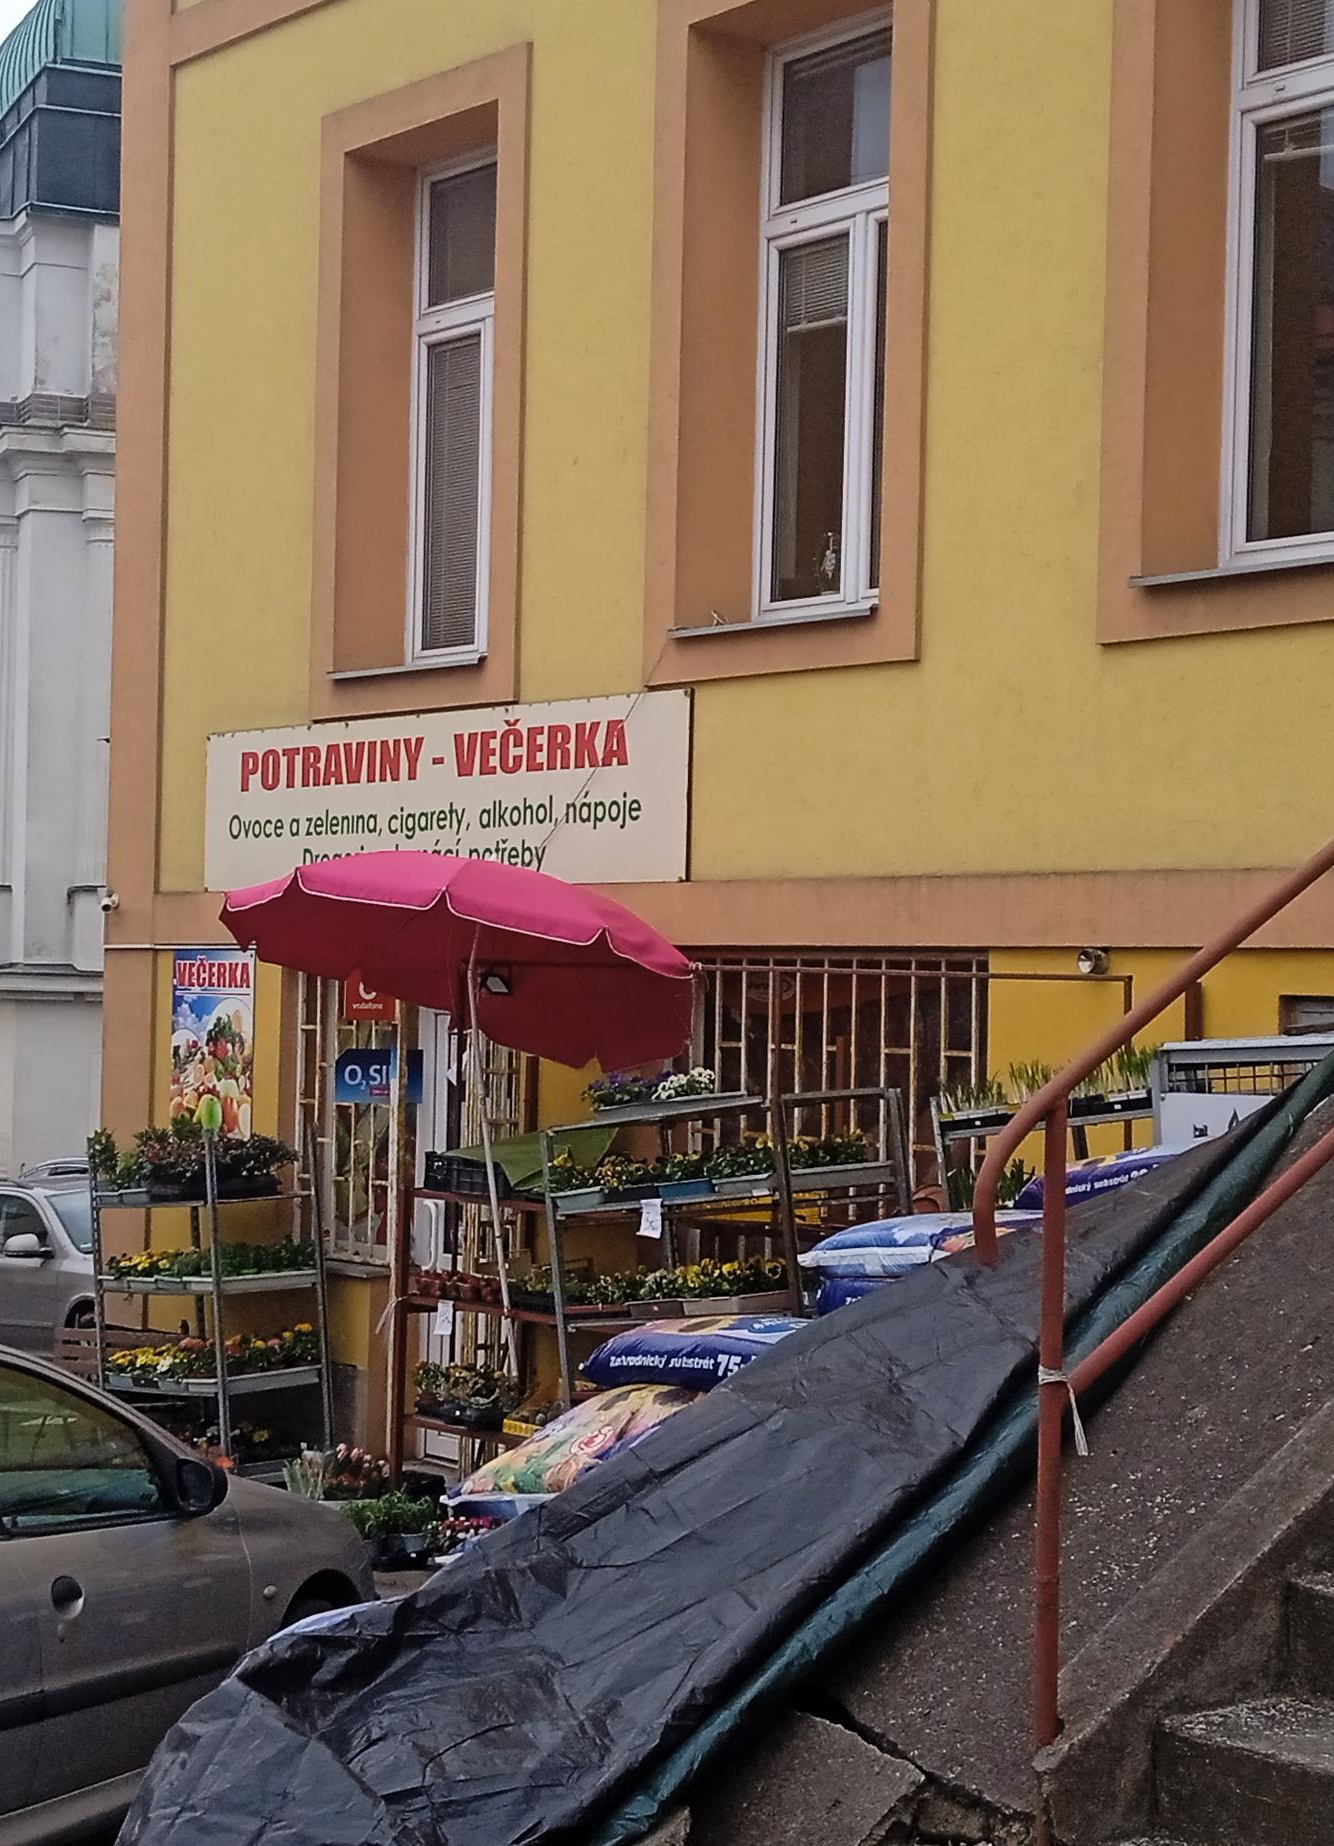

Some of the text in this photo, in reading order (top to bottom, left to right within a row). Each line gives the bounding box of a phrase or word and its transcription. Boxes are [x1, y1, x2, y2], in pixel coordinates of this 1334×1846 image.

[240, 718, 629, 793] POTRAVINY - VEČERKA
[229, 814, 284, 840] Ovoce
[289, 816, 300, 838] a
[387, 801, 471, 840] cigarety,
[478, 794, 558, 829] alkohol,
[565, 790, 642, 830] nápoje
[177, 956, 251, 989] VEČERKA
[369, 1064, 388, 1085] SI
